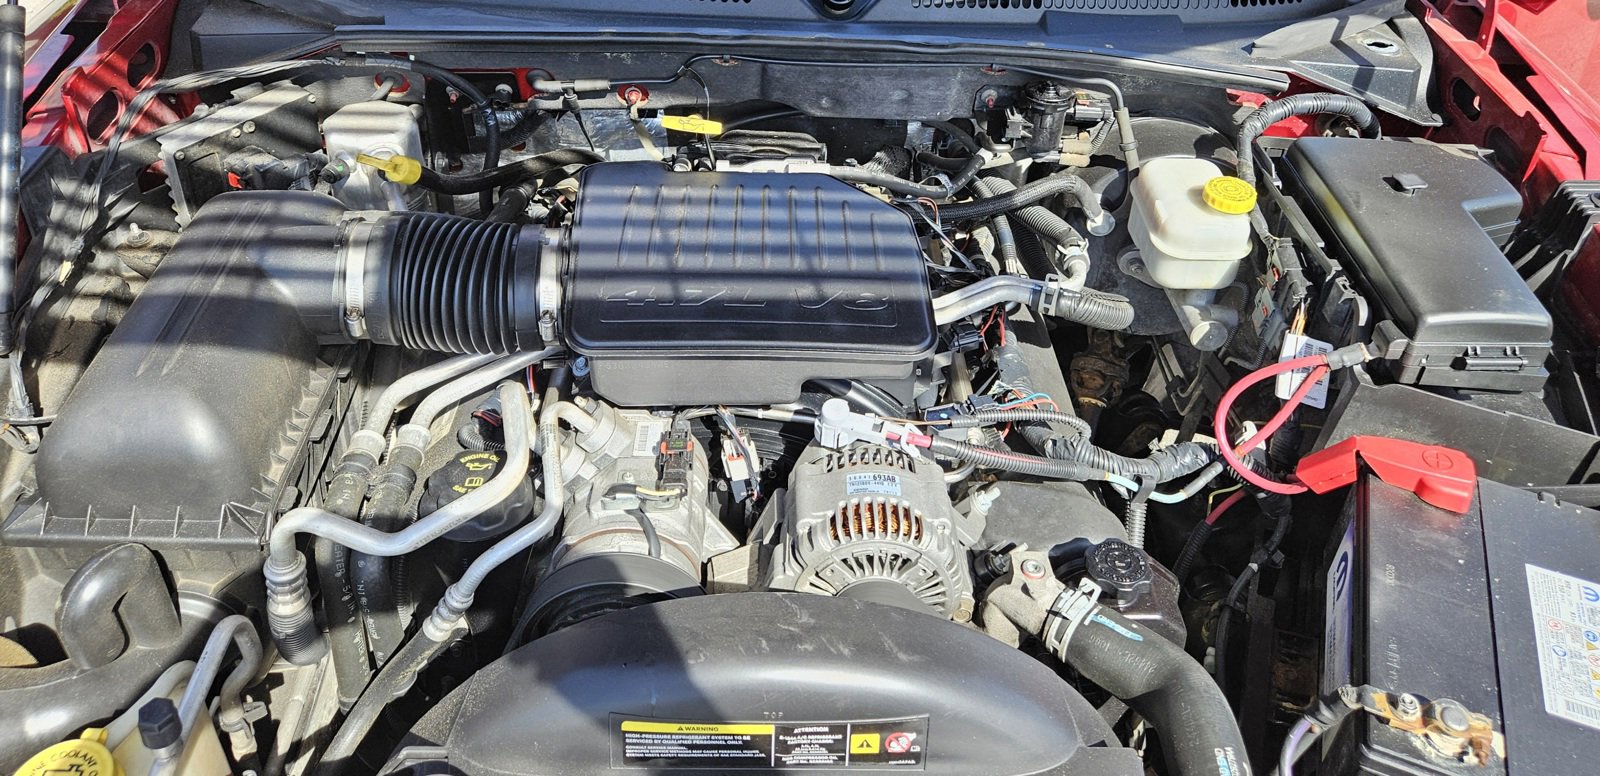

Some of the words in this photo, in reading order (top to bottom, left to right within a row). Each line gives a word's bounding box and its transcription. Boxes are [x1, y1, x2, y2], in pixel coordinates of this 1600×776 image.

[606, 286, 767, 307] 4.7L
[794, 287, 890, 311] V8
[460, 453, 490, 463] ENGINE
[872, 474, 897, 483] 693AB
[334, 543, 346, 574] EATER
[763, 711, 784, 720] TOP
[51, 749, 99, 768] COOLANT
